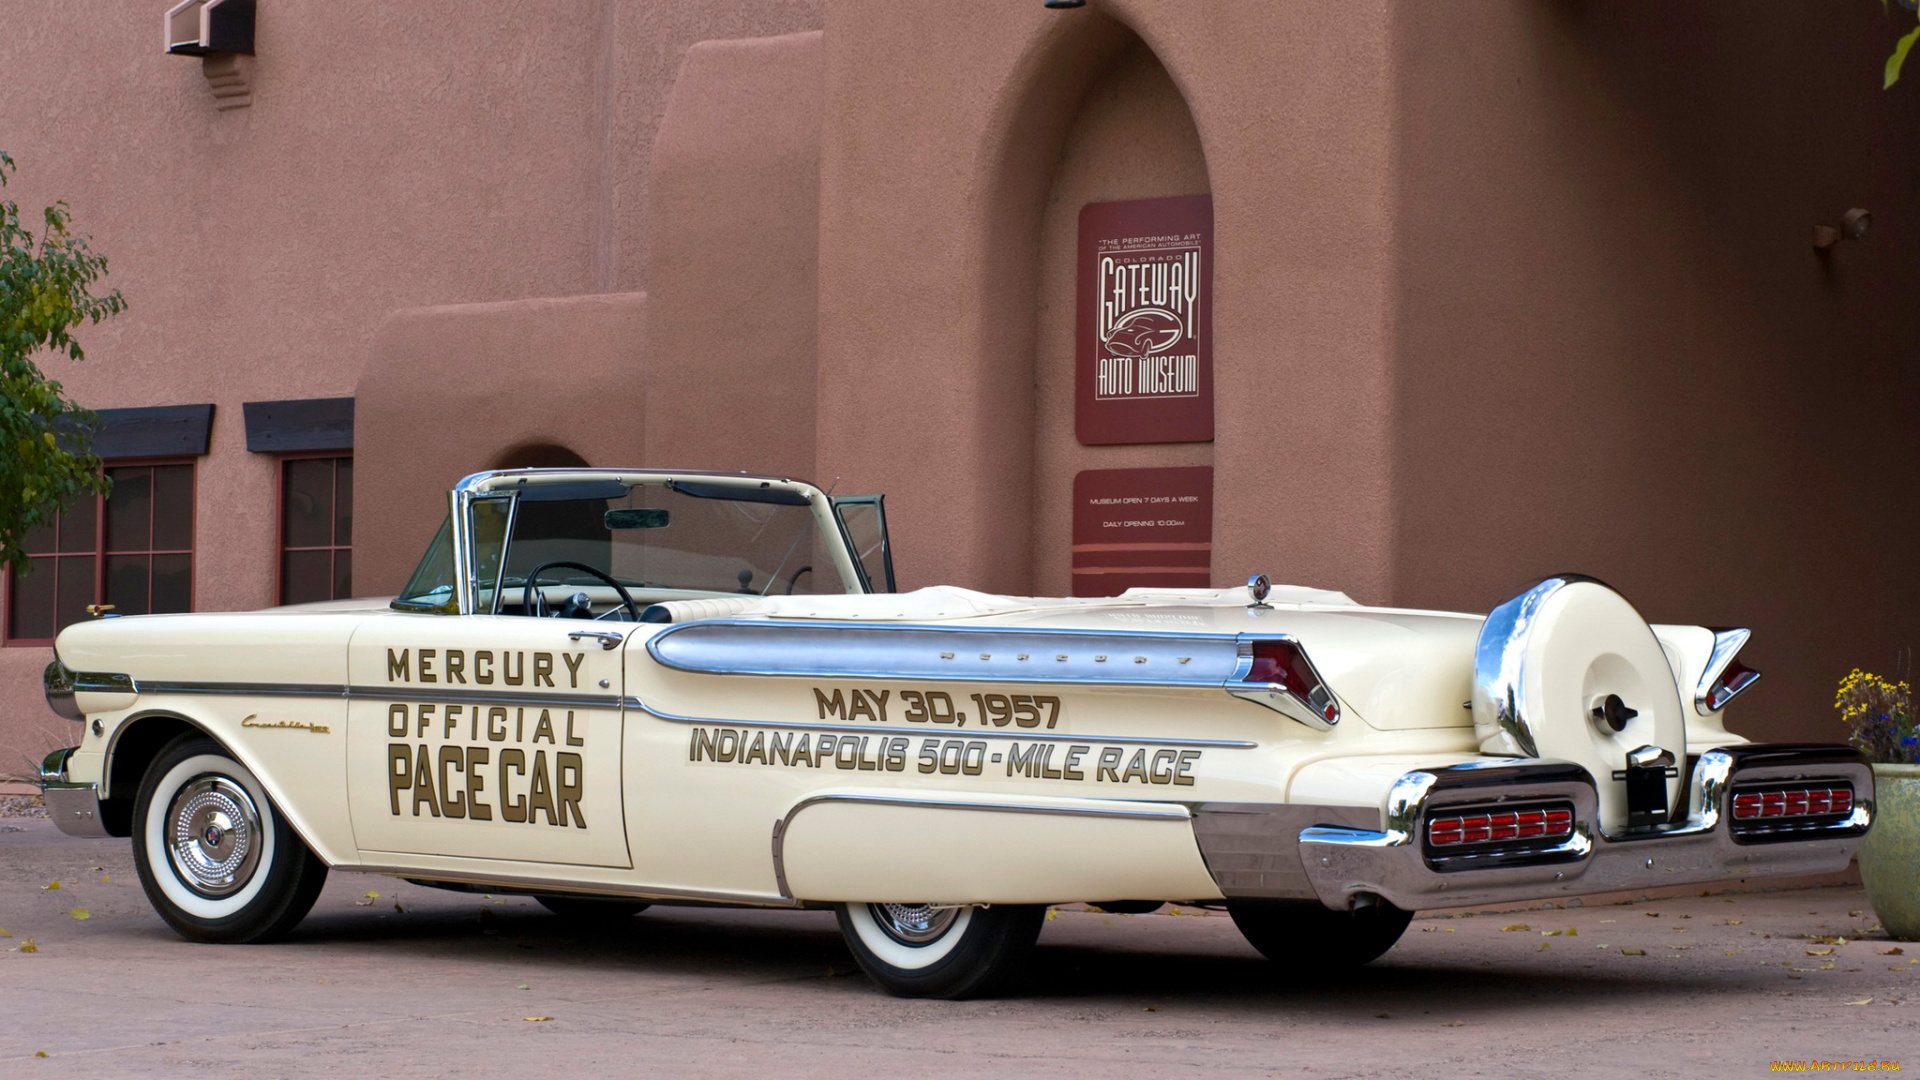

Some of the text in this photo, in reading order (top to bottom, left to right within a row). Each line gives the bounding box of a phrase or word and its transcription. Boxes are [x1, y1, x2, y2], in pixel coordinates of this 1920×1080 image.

[1115, 255, 1183, 264] COLORADO
[1122, 235, 1180, 245] PERFORMING
[1099, 251, 1197, 342] GATEWAY
[1098, 355, 1196, 396] AUTO MUSEUM
[1150, 496, 1170, 504] DAYS
[1123, 520, 1155, 528] OPENING
[387, 648, 585, 688] MERCURY
[812, 687, 889, 721] MAY
[388, 703, 585, 747] OFFICIAL
[689, 728, 909, 772] INDIANAPOLIS
[1096, 747, 1202, 787] RACE
[388, 743, 588, 829] PACE CAR
